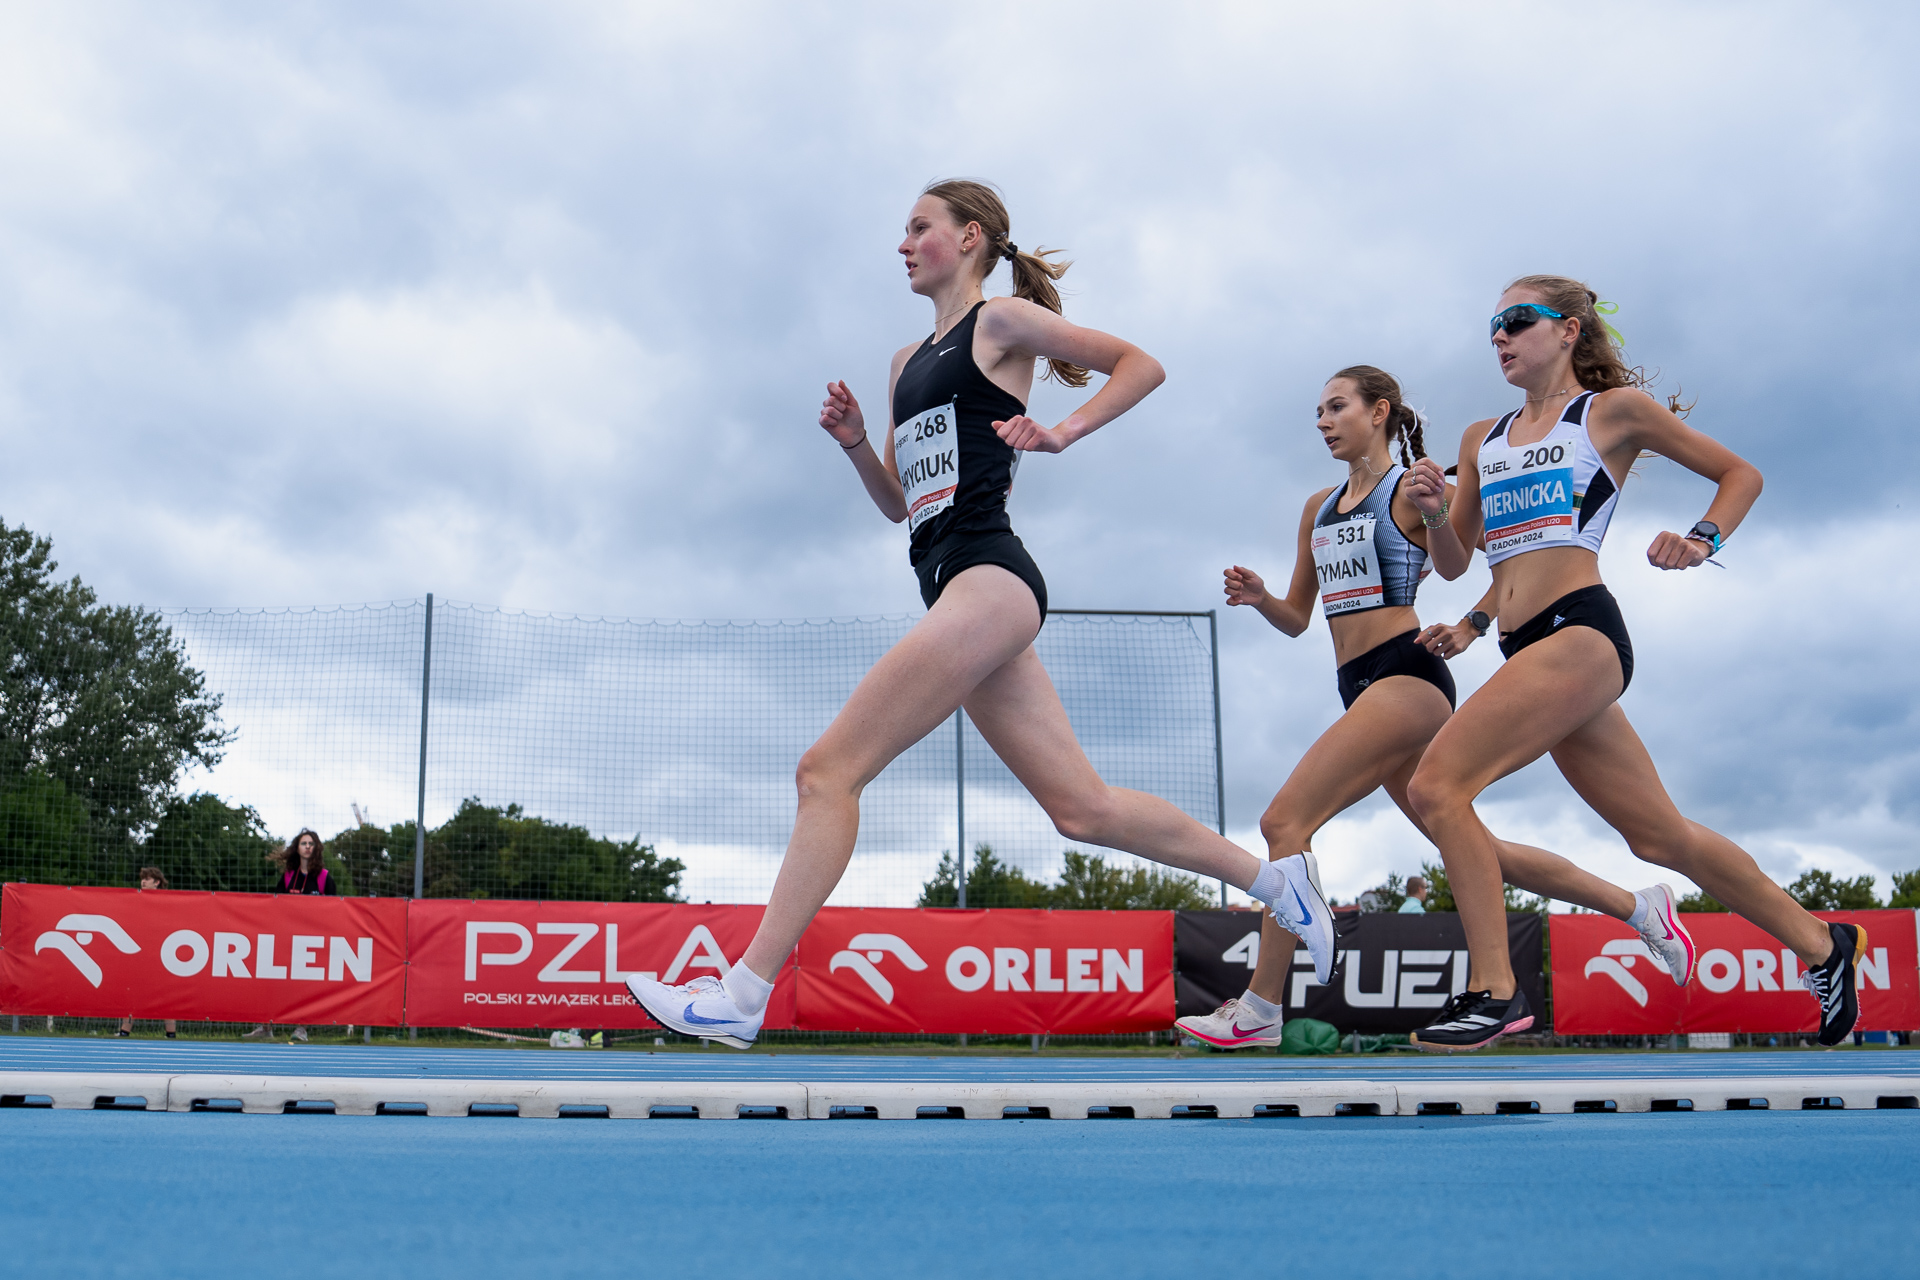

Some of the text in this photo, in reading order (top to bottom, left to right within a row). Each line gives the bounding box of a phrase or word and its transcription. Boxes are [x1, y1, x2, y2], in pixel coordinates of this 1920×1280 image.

[915, 414, 947, 442] 268
[1522, 445, 1564, 469] 200
[1482, 461, 1511, 477] FUEL
[924, 504, 939, 517] 2024
[1350, 511, 1375, 519] UKS
[1546, 517, 1561, 525] U20
[1337, 525, 1365, 545] 531
[1491, 532, 1543, 551] RADOM 2024
[1342, 600, 1361, 608] 2024
[160, 929, 373, 982] ORLEN
[464, 921, 733, 983] PZLA
[945, 945, 1143, 992] ORLEN
[1697, 947, 1891, 993] ORLN
[464, 992, 522, 1005] POLSKI
[526, 993, 600, 1007] ZWIĄZEK
